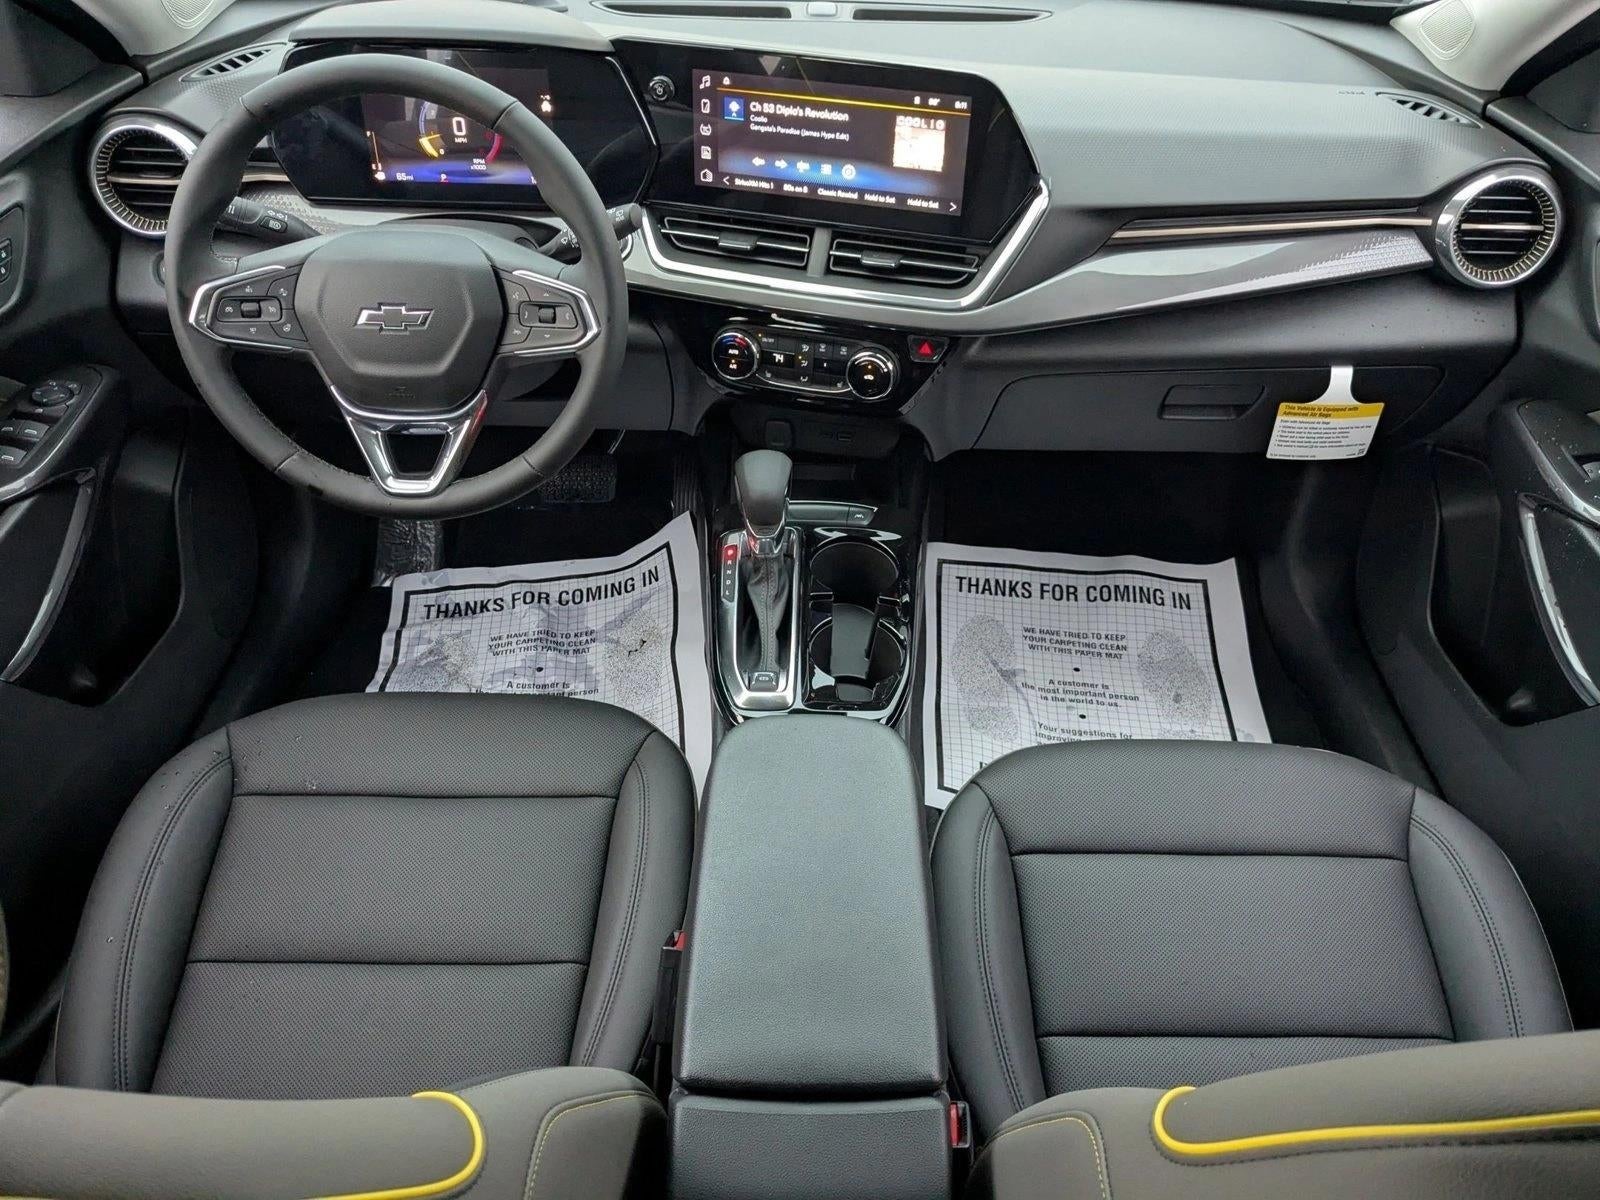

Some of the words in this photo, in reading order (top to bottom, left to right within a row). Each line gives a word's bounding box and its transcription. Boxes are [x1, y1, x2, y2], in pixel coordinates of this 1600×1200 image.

[750, 102, 761, 112] Ch
[776, 104, 804, 117] Diplo's
[805, 107, 849, 121] Revolution
[750, 114, 768, 123] Coolio
[452, 117, 466, 136] 0
[777, 126, 800, 136] Paradise
[801, 128, 820, 137] (James
[821, 131, 835, 140] Hype
[836, 132, 849, 142] Edit)
[817, 188, 837, 197] Classic
[837, 190, 858, 199] Rewind
[864, 193, 878, 201] Hold
[907, 198, 921, 206] Hold
[928, 200, 939, 208] Set
[772, 353, 783, 363] 74
[423, 597, 505, 620] THANKS
[511, 590, 550, 610] FOR
[558, 577, 635, 606] COMING
[642, 565, 659, 588] IN
[955, 575, 1033, 600] THANKS
[1039, 582, 1079, 603] FOR
[1085, 584, 1166, 608] COMING
[1171, 591, 1192, 611] IN
[490, 634, 505, 642] WE
[506, 631, 530, 640] HAVE
[532, 628, 557, 638] TRIED
[560, 631, 572, 640] TO
[573, 629, 596, 638] KEEP
[1038, 628, 1061, 637] HAVE
[1063, 630, 1089, 640] TRIED
[1090, 632, 1102, 640] TO
[1104, 634, 1126, 642] KEEP
[488, 640, 513, 651] YOUR
[515, 637, 565, 648] CARPETING
[567, 637, 596, 648] CLEAN
[1022, 634, 1048, 644] YOUR
[1048, 638, 1098, 650] CARPETING
[1098, 642, 1128, 652] CLEAN
[492, 647, 515, 657] WITH
[518, 644, 540, 654] THIS
[541, 645, 571, 656] PAPER
[572, 647, 592, 656] MAT
[1028, 644, 1052, 652] WITH
[1053, 646, 1073, 656] THIS
[1074, 649, 1103, 659] PAPER
[1104, 652, 1124, 660] MAT
[506, 680, 513, 688] A
[515, 680, 560, 690] customer
[562, 681, 570, 689] is
[1021, 682, 1036, 690] the
[1038, 686, 1060, 694] most
[1062, 688, 1107, 699] important
[1108, 693, 1140, 702] person
[1056, 680, 1100, 690] customer
[567, 688, 599, 698] person
[1051, 695, 1066, 703] the
[1068, 698, 1094, 706] world
[1038, 721, 1058, 733] Your
[1060, 728, 1117, 739] suggestions
